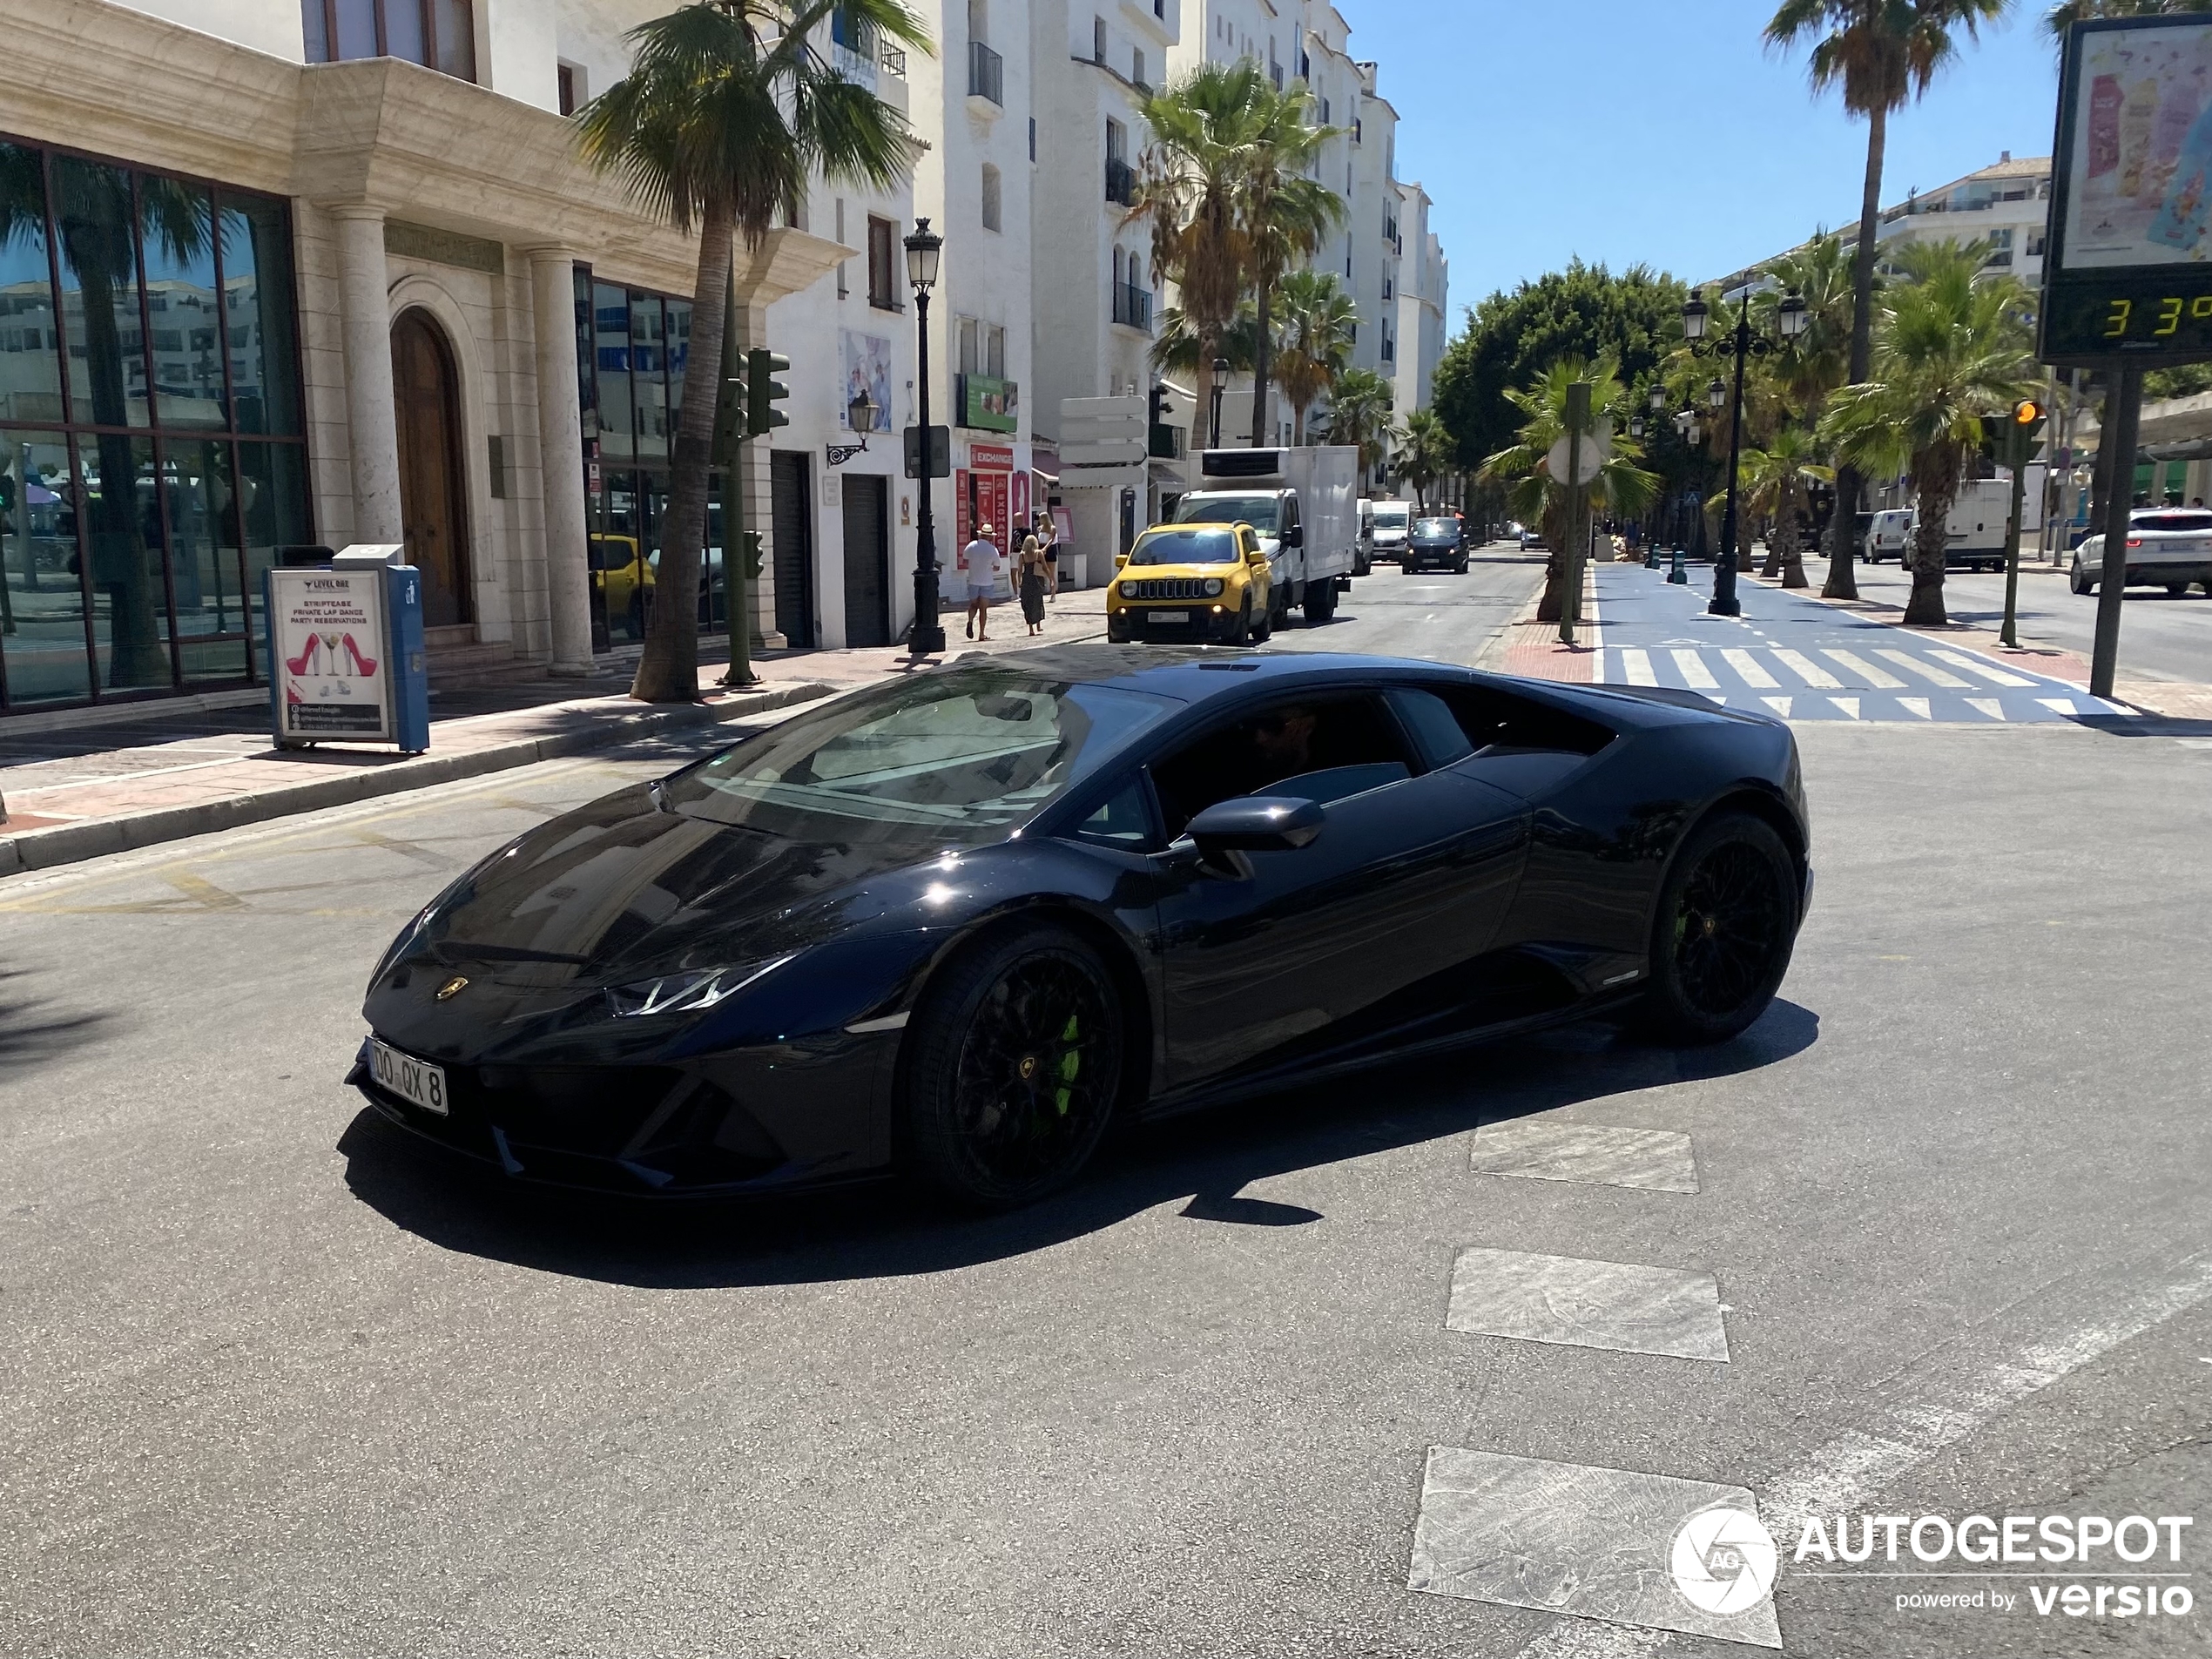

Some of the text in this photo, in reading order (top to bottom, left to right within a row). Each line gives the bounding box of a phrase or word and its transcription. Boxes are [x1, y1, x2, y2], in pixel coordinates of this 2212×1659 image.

[977, 452, 1013, 464] EXCHANGE
[314, 580, 334, 589] LEVEL
[374, 1045, 442, 1107] DO QX 8
